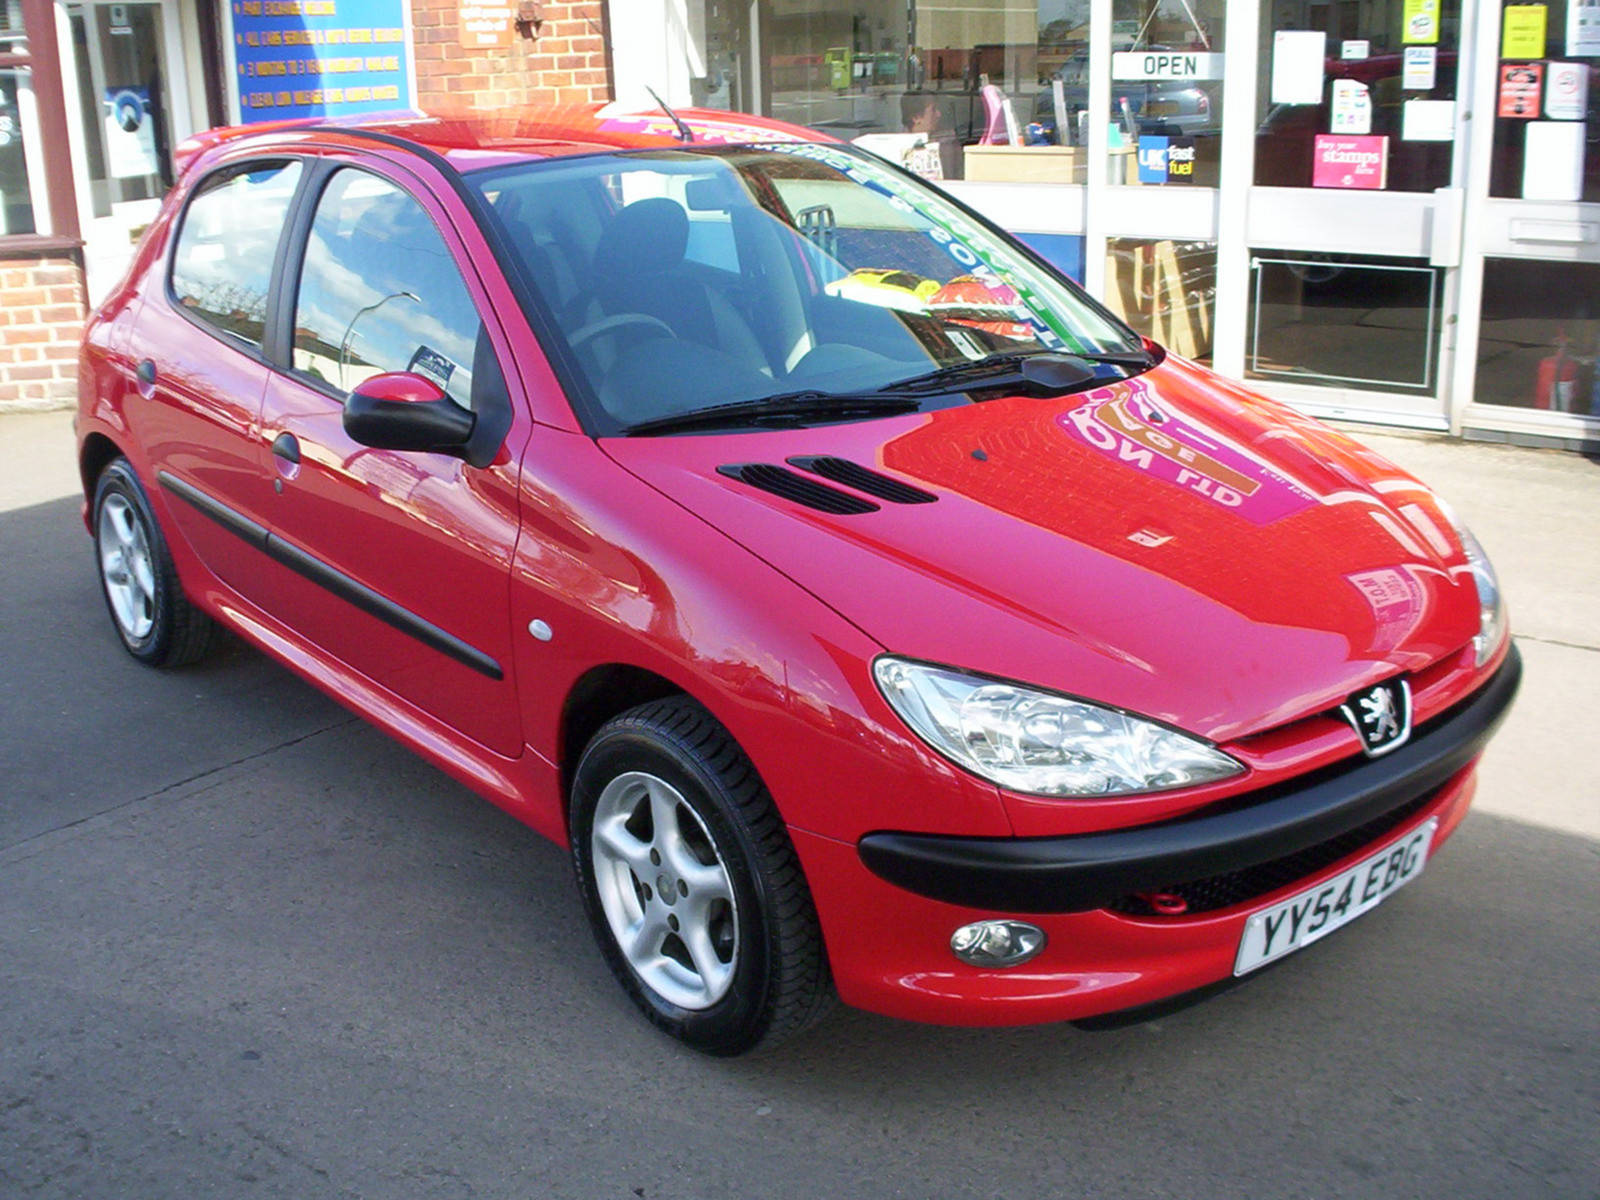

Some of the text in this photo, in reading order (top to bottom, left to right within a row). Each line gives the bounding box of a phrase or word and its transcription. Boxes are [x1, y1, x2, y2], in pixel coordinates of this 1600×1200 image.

[1144, 56, 1196, 75] OPEN
[1139, 149, 1166, 165] UK
[1166, 145, 1195, 160] fast
[1323, 150, 1380, 168] stamps
[1169, 160, 1192, 175] fuel
[1263, 834, 1423, 957] YY54 EBG
